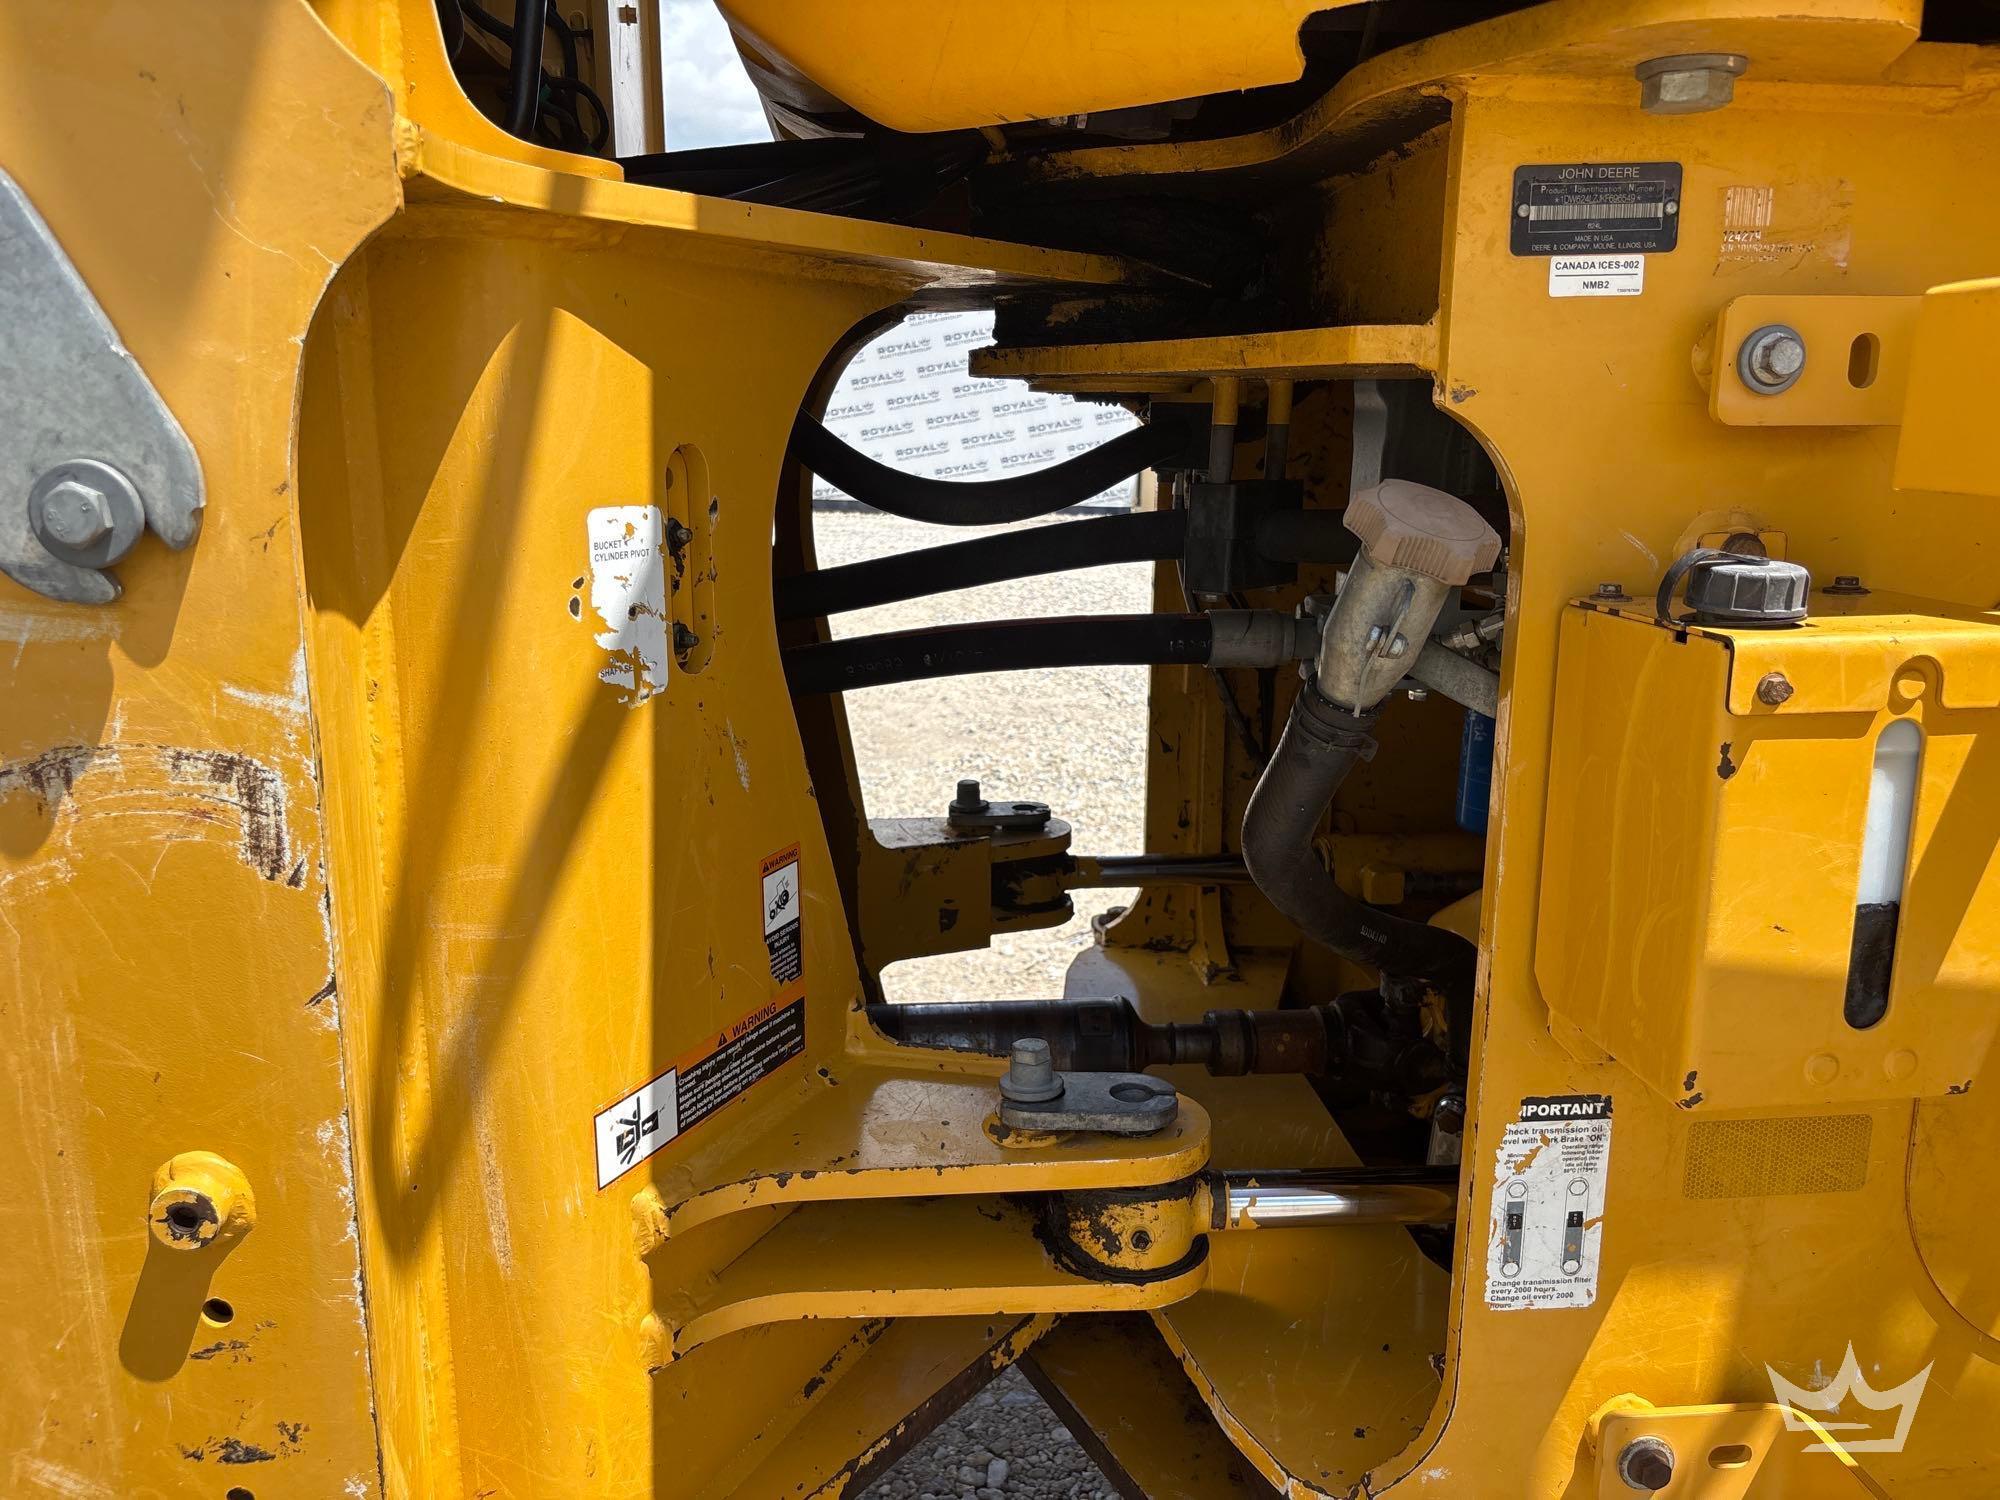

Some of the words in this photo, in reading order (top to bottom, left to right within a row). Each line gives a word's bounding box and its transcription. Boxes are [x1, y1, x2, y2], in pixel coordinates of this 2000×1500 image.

[1558, 168, 1593, 179] JOHN
[1599, 167, 1640, 178] DEERE
[1541, 185, 1568, 194] Product
[1574, 184, 1621, 193] Identification
[1555, 261, 1596, 270] CANADA
[1598, 260, 1640, 269] ICES-002
[1582, 280, 1610, 289] NMB2
[944, 329, 985, 342] ROYAL
[877, 341, 917, 354] ROYAL
[917, 361, 958, 373] ROYAL
[851, 374, 892, 386] ROYAL
[952, 381, 994, 393] ROYAL
[887, 393, 928, 406] ROYAL
[992, 399, 1033, 412] ROYAL
[927, 412, 967, 425] ROYAL
[861, 424, 900, 436] ROYAL
[1027, 418, 1069, 432] ROYAL
[961, 431, 1001, 444] ROYAL
[895, 444, 936, 456] ROYAL
[1000, 450, 1041, 464] ROYAL
[935, 463, 975, 475] ROYAL
[594, 540, 622, 550] BUCKET
[594, 551, 628, 562] CYLINDER
[630, 548, 649, 558] PIVOT
[769, 848, 798, 869] WARNING
[732, 1003, 777, 1037] WARNING
[678, 1068, 701, 1085] Crushing
[702, 1058, 715, 1071] injury
[716, 1052, 726, 1061] may
[726, 1041, 740, 1055] result
[758, 1025, 768, 1034] area
[772, 1011, 790, 1025] machine
[679, 1090, 692, 1102] Make
[693, 1084, 704, 1093] sure
[704, 1072, 720, 1086] people
[729, 1059, 740, 1069] clear
[746, 1042, 765, 1058] machine
[765, 1033, 779, 1046] before
[779, 1022, 796, 1037] starting
[679, 1097, 696, 1111] engine
[702, 1080, 720, 1095] moving
[721, 1067, 740, 1082] steering
[680, 1105, 696, 1120] Attach
[696, 1094, 714, 1108] locking
[714, 1088, 722, 1096] bar
[723, 1077, 738, 1090] before
[738, 1061, 762, 1080] performing
[762, 1050, 778, 1064] service
[686, 1106, 706, 1123] machine
[1507, 1128, 1530, 1136] heck
[1532, 1126, 1589, 1135] transmission
[1592, 1124, 1603, 1133] oil
[1502, 1138, 1520, 1146] evel
[1521, 1136, 1538, 1144] with
[1491, 1280, 1521, 1288] Change
[1522, 1277, 1572, 1286] transmission
[1534, 1286, 1558, 1294] hours.
[1490, 1294, 1520, 1302] Change
